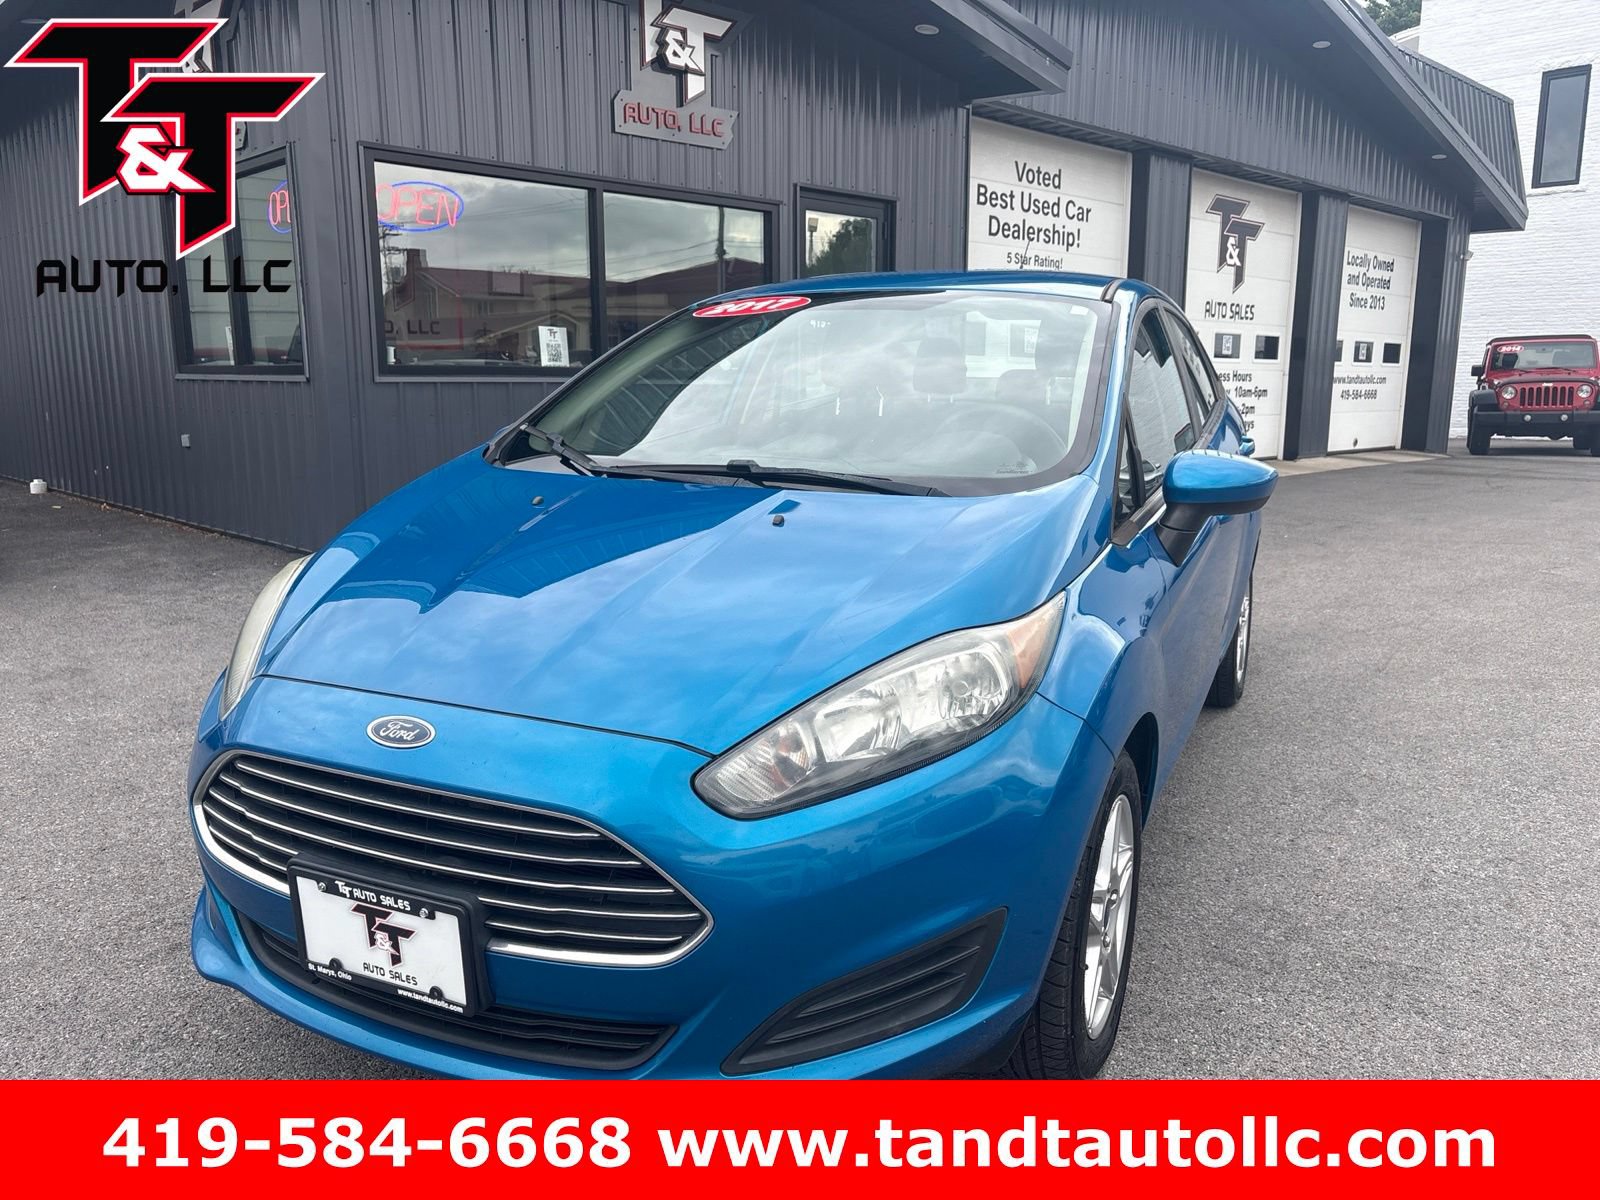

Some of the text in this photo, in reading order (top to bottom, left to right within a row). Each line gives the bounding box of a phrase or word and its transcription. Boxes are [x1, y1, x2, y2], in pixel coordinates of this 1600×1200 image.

[623, 102, 726, 138] AUTO, LLC
[1014, 160, 1062, 190] Voted
[375, 183, 460, 227] OPEN
[976, 183, 1092, 223] Best Used Car
[988, 214, 1081, 252] Dealership!
[1006, 251, 1064, 270] 5 Star Rating!
[1346, 251, 1395, 273] Locally Owned
[1347, 272, 1391, 291] and Operated
[1204, 299, 1255, 321] AUTO SALES
[1349, 292, 1386, 311] Since 2013
[1232, 370, 1252, 383] Hours
[1340, 389, 1377, 400] 419-584-6668
[379, 720, 420, 741] Ford
[353, 889, 378, 903] AUTO
[380, 894, 411, 911] SALES
[308, 962, 317, 971] St.
[337, 971, 352, 981] Ohio
[363, 962, 418, 986] AUTO SALES
[397, 988, 463, 1014] www.tandtautollc.com
